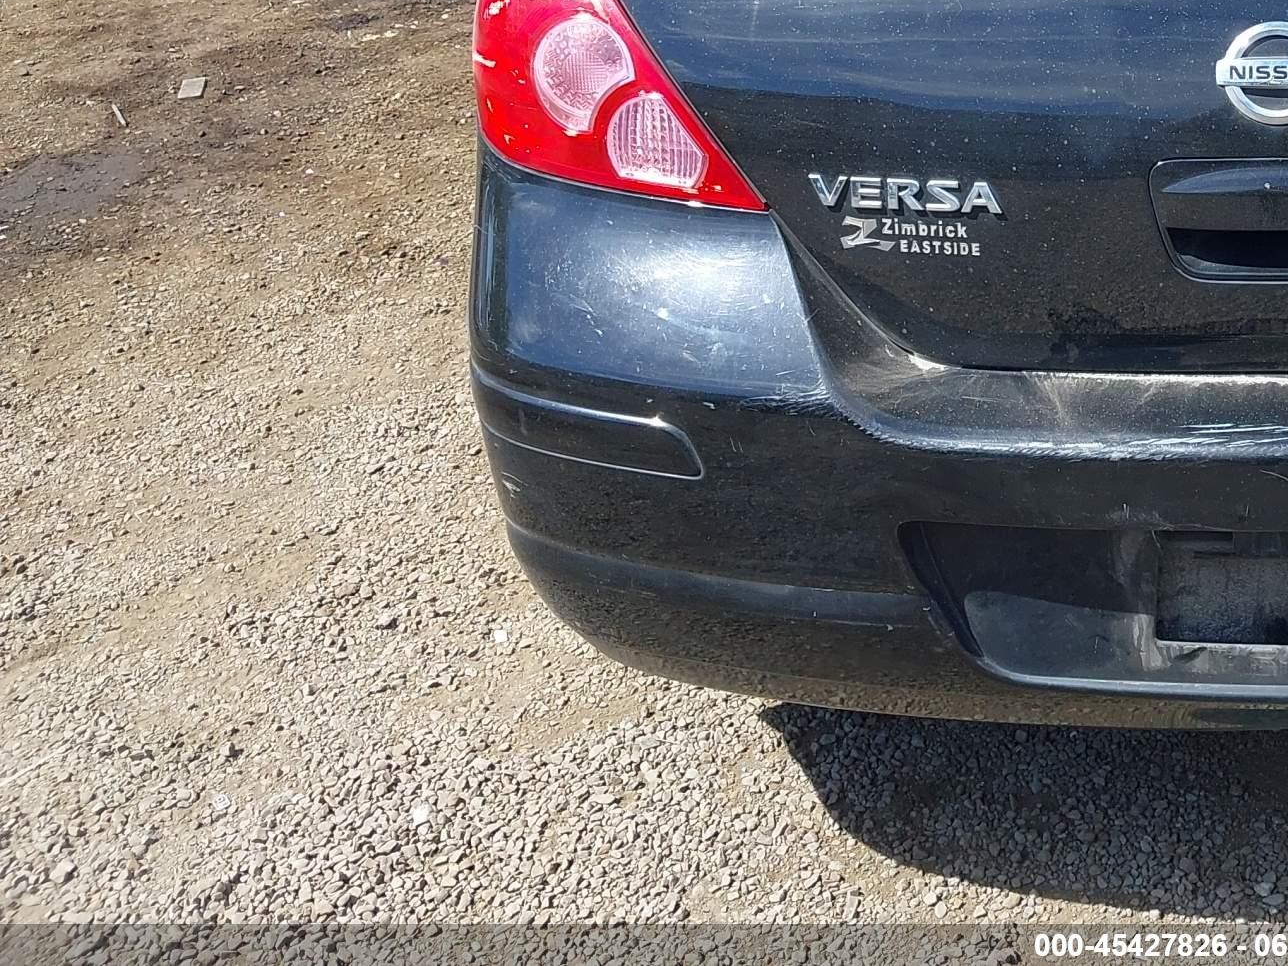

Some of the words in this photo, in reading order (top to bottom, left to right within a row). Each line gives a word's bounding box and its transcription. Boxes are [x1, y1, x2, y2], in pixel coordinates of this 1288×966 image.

[808, 174, 1003, 214] VERSA
[881, 218, 968, 238] Zimbrick
[900, 239, 981, 256] EASTSIDE
